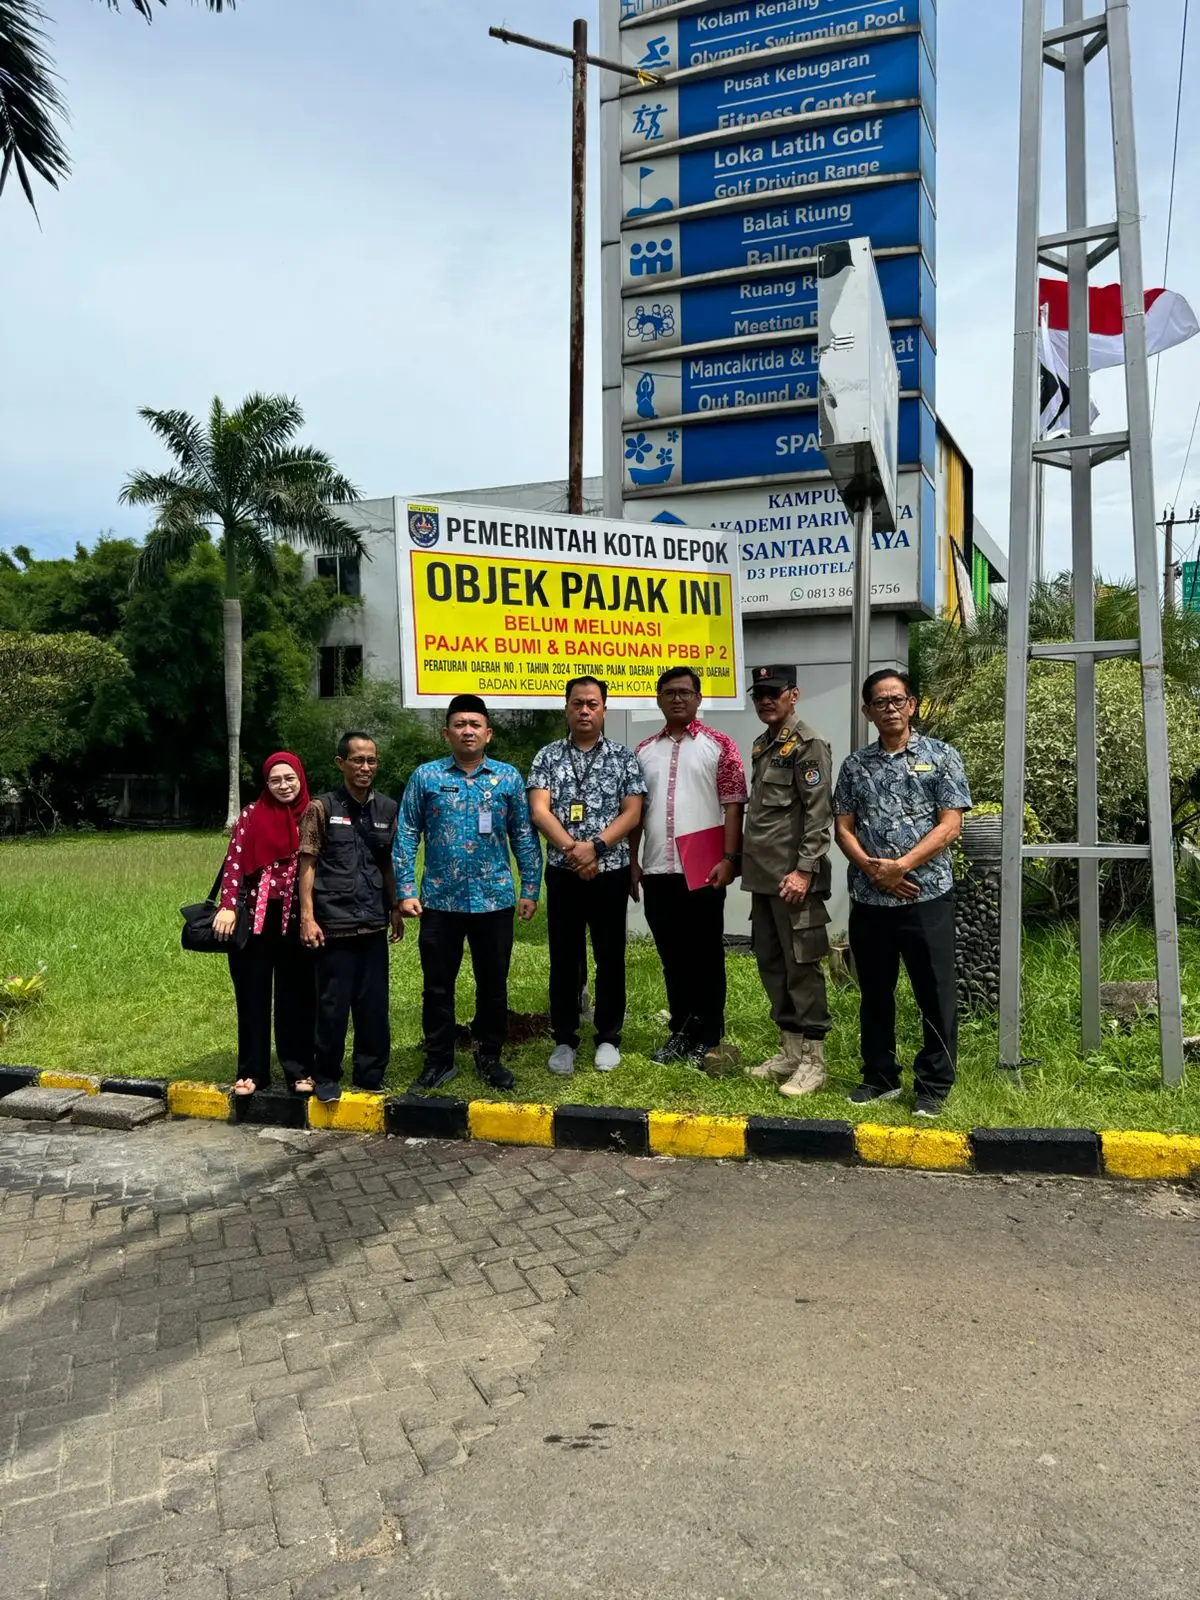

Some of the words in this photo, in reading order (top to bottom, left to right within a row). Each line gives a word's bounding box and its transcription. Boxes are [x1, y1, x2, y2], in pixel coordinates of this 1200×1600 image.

[697, 10, 750, 32] Kolam
[764, 22, 858, 48] Swimming
[863, 6, 905, 30] Pool
[724, 72, 770, 94] Pusat
[775, 53, 870, 84] Kebugaran
[718, 105, 793, 130] Fitness
[800, 89, 877, 114] Center
[713, 146, 764, 169] Loka
[771, 131, 826, 158] Latih
[832, 119, 883, 144] Golf
[714, 179, 751, 200] Golf
[755, 169, 819, 193] Driving
[824, 158, 880, 181] Range
[743, 211, 789, 234] Balai
[795, 203, 851, 224] Riung
[739, 279, 796, 299] Ruang
[734, 312, 804, 335] Meeting
[690, 349, 784, 380] Mancakrida
[790, 347, 805, 367] &
[698, 393, 729, 411] Out
[734, 382, 790, 408] Bound
[795, 382, 810, 401] &
[775, 432, 820, 456] SPA
[446, 516, 597, 554] PEMERINTAH
[604, 532, 657, 560] KOTA
[663, 537, 729, 565] DEPOK
[738, 535, 851, 562] SANTARA
[747, 568, 765, 580] D3
[770, 561, 854, 579] PERHOTELA
[426, 561, 550, 608] OBJEK
[560, 571, 670, 614] PAJAK
[679, 579, 722, 616] INI
[807, 588, 835, 599] 0813
[504, 615, 568, 634] BELUM
[574, 618, 661, 637] MELUNASI
[424, 634, 488, 654] PAJAK
[494, 637, 541, 655] BUMI
[547, 639, 559, 655] &
[565, 640, 663, 659] BANGUNAN
[667, 643, 700, 660] PBB
[705, 645, 715, 660] P
[719, 645, 727, 660] 2
[424, 659, 468, 673] PERATURAN
[471, 661, 500, 673] DAERAH
[526, 662, 549, 674] TAHUN
[552, 662, 570, 674] 2024
[574, 663, 603, 676] TENTANG
[606, 664, 626, 676] PAJAK
[629, 664, 655, 676] DAERAH
[707, 666, 730, 677] DAERAH
[478, 678, 517, 690] BADAN
[520, 679, 566, 691] KEUANG
[626, 680, 653, 692] KOTA
